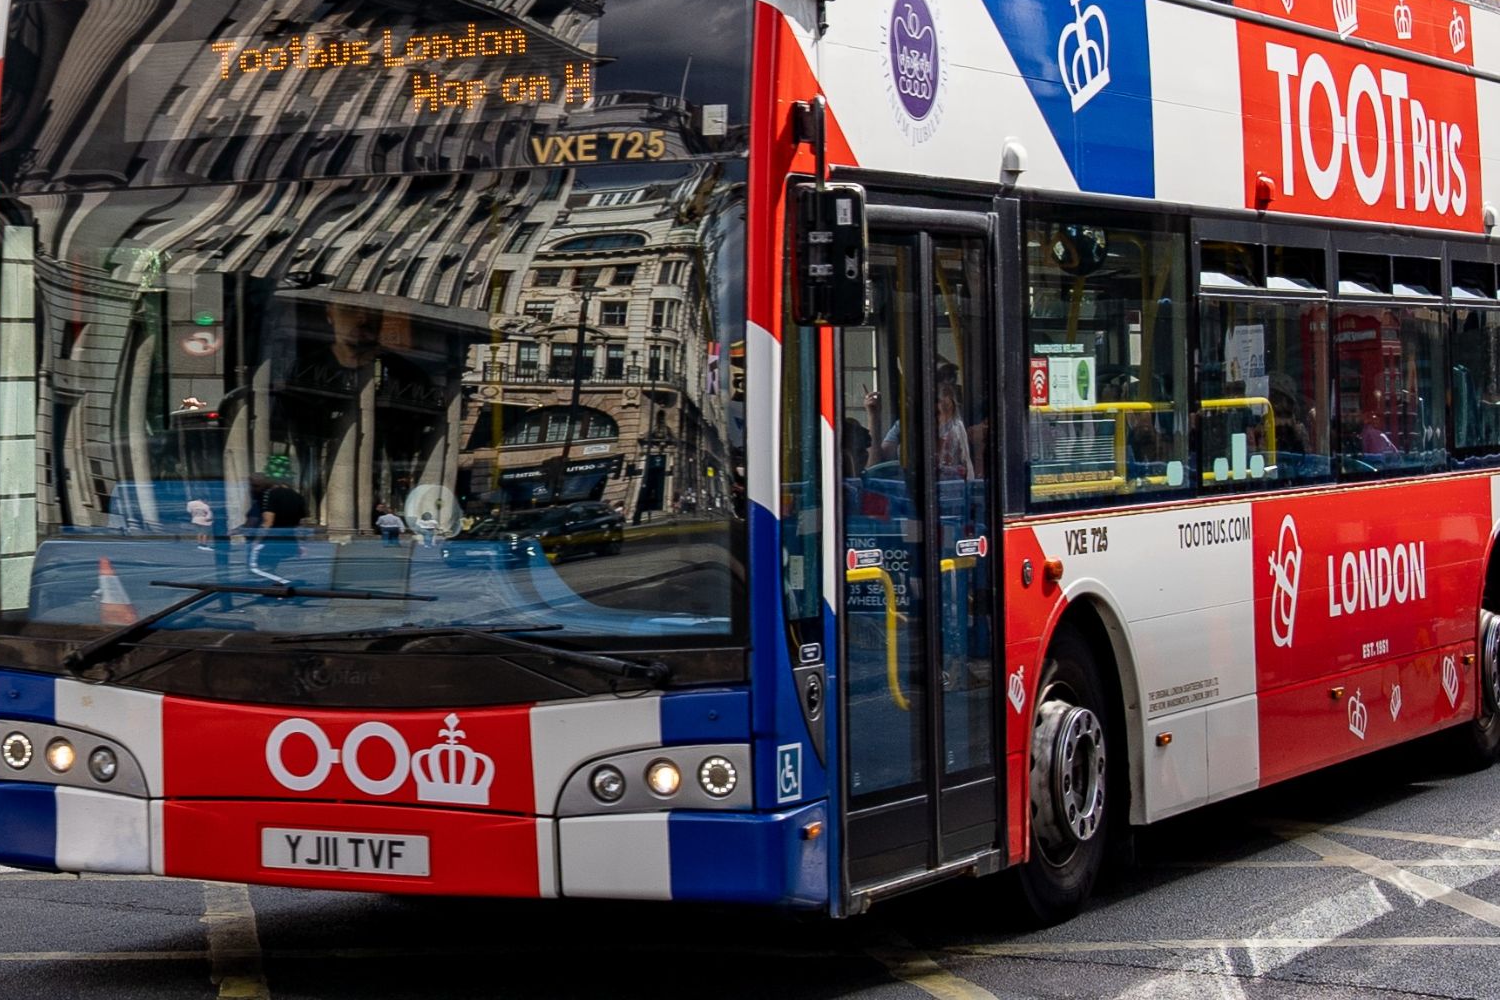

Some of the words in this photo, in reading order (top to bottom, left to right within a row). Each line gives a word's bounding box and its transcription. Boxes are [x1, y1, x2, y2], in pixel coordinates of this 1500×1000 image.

[210, 34, 370, 80] Tootbus
[382, 23, 527, 68] London
[412, 72, 487, 114] Hop
[501, 75, 551, 104] on
[564, 62, 591, 104] H
[531, 133, 598, 166] VXE
[607, 130, 666, 160] 725
[1065, 528, 1088, 556] VXE
[1090, 526, 1108, 553] 725
[1178, 516, 1251, 549] TOOTBUS.COM
[1327, 540, 1426, 618] LONDON
[284, 833, 339, 867] YJ11
[347, 837, 405, 870] TVF
